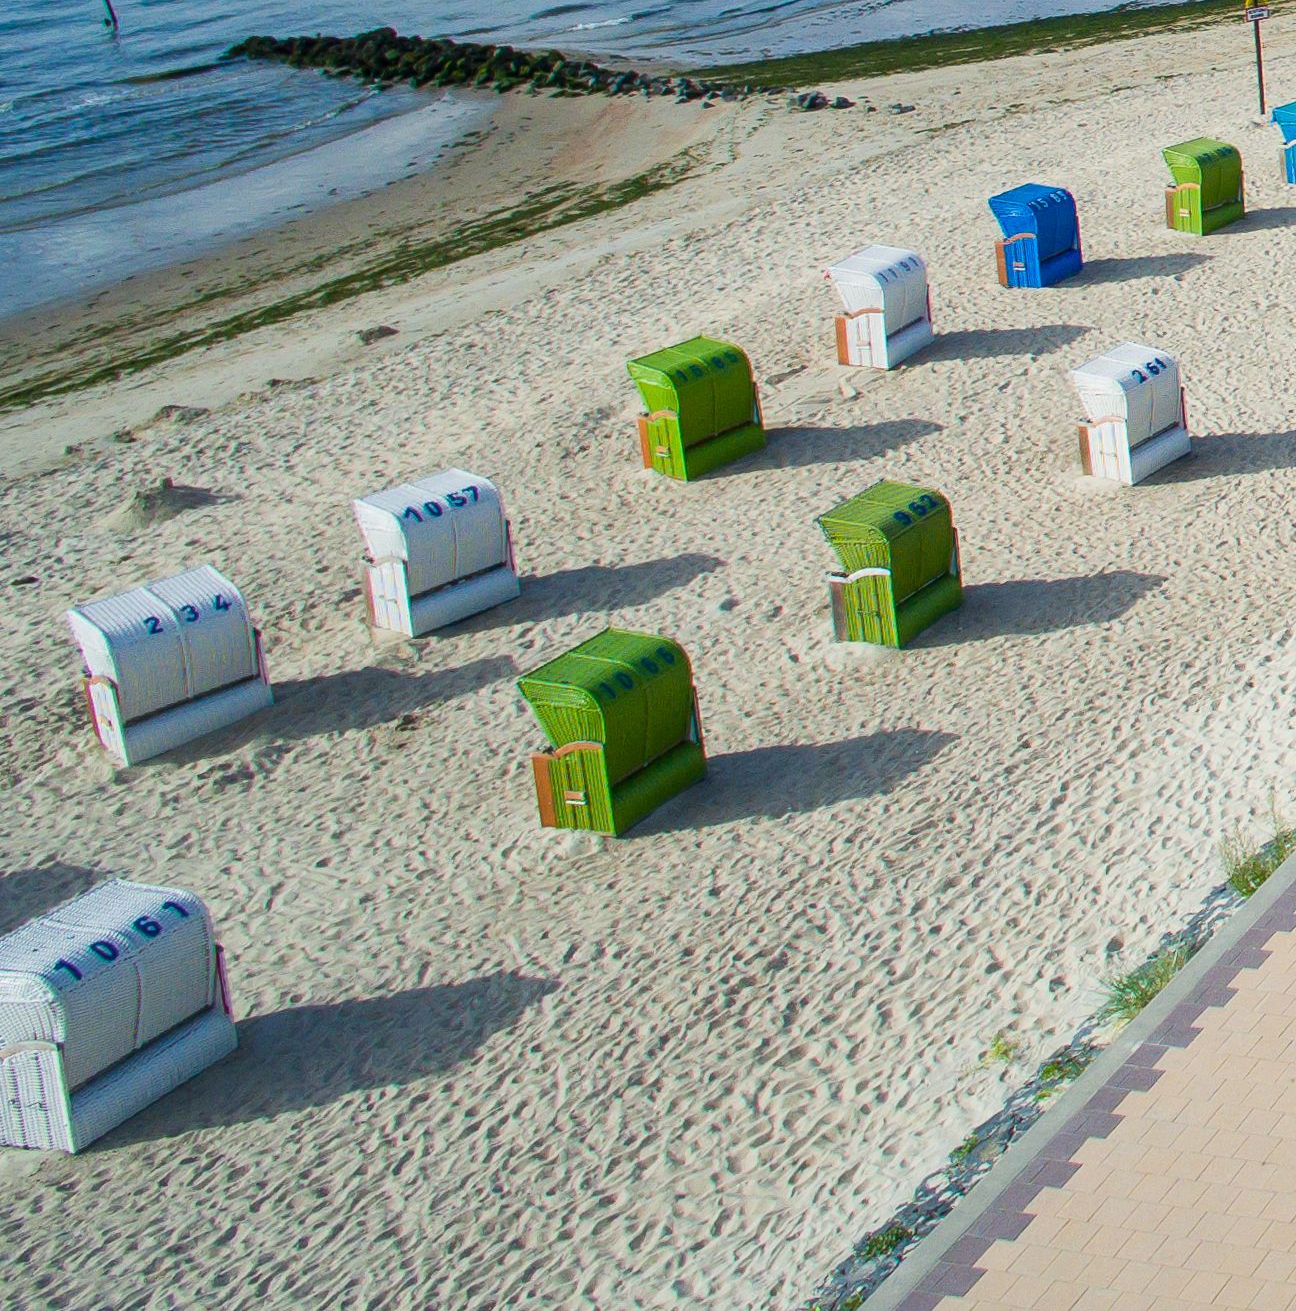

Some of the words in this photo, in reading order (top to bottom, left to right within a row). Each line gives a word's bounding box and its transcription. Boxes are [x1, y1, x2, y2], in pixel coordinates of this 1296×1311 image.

[1131, 357, 1168, 384] 261
[401, 485, 480, 523] 1057
[142, 593, 233, 636] 234
